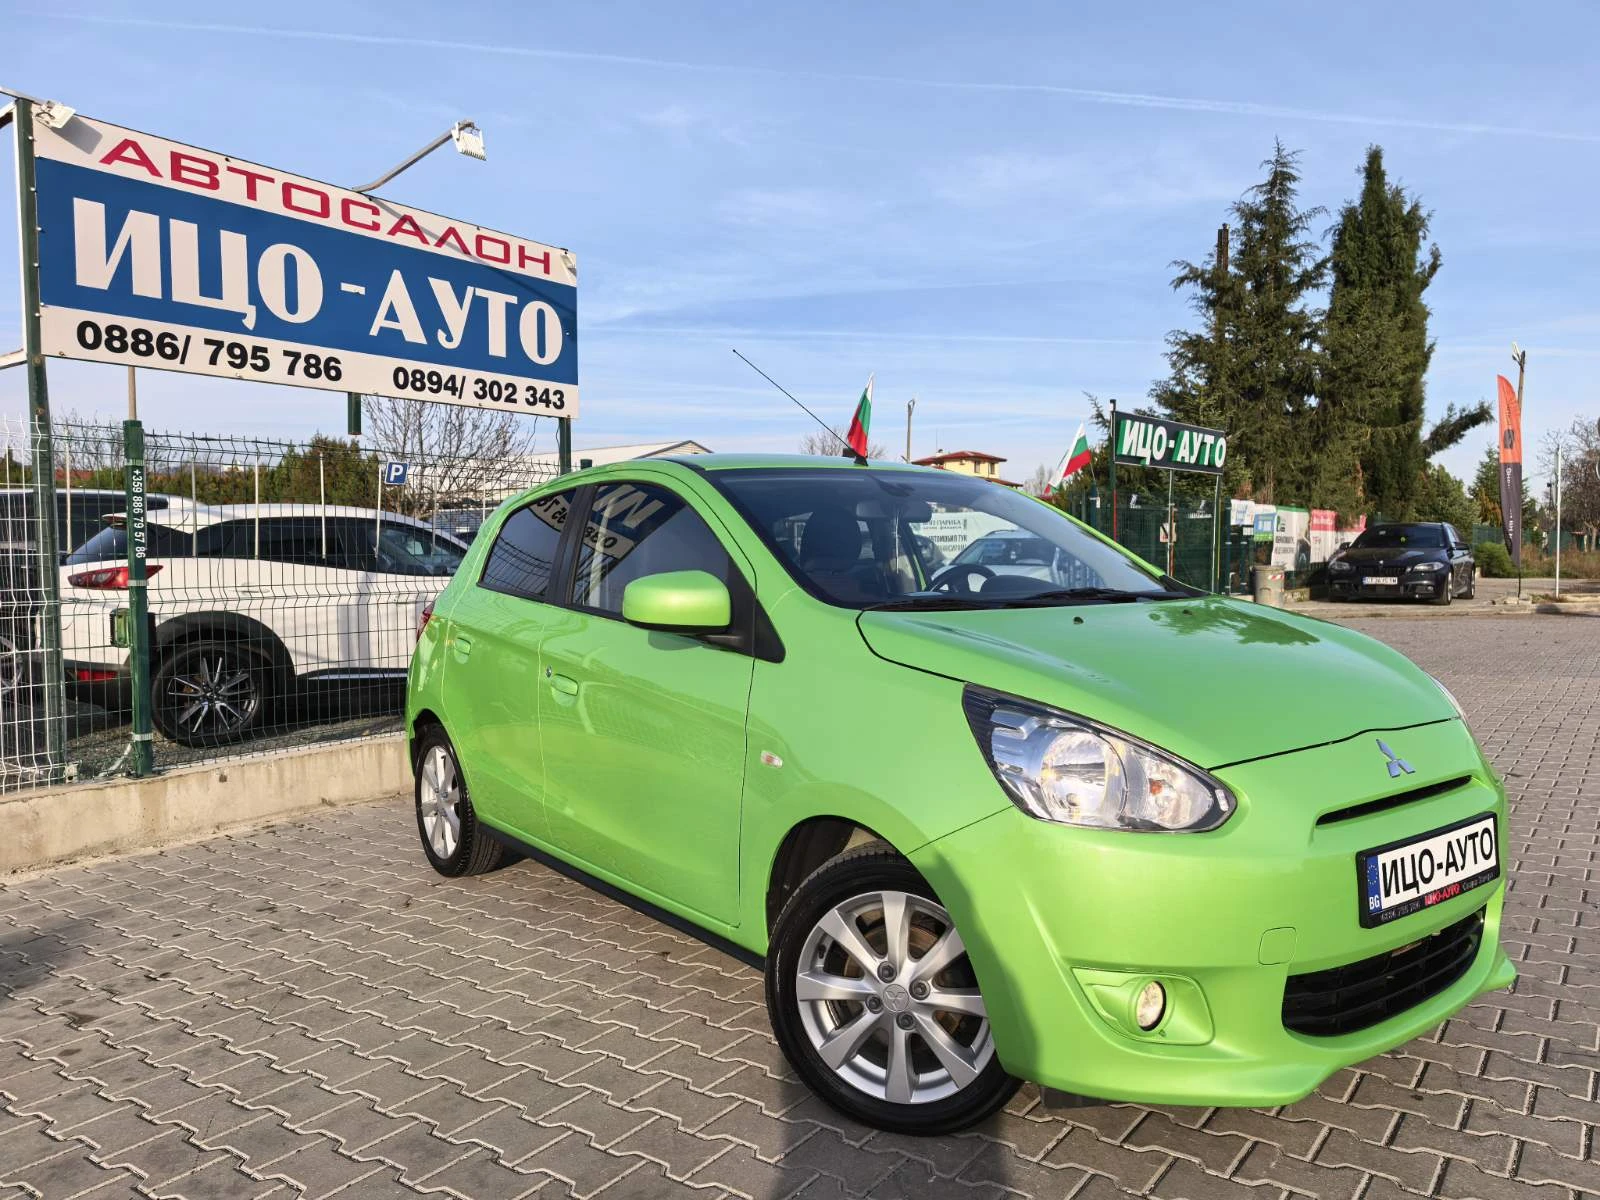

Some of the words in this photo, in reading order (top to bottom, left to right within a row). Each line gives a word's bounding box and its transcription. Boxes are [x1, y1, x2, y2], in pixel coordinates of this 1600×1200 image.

[100, 138, 551, 275] АВТОСАЛОН
[76, 320, 191, 367] 0886/
[203, 339, 271, 373] 795
[282, 350, 343, 382] 786
[392, 366, 466, 398] 0894/
[473, 378, 518, 402] 302
[525, 385, 565, 410] 343
[1117, 419, 1227, 468] ИЦО-АУТО
[132, 469, 143, 493] +359
[133, 496, 144, 513] 886
[134, 517, 145, 529] 79
[135, 531, 146, 543] 57
[136, 546, 147, 559] 86
[1382, 827, 1493, 898] ИЦО-АУТО
[1369, 894, 1380, 910] BG
